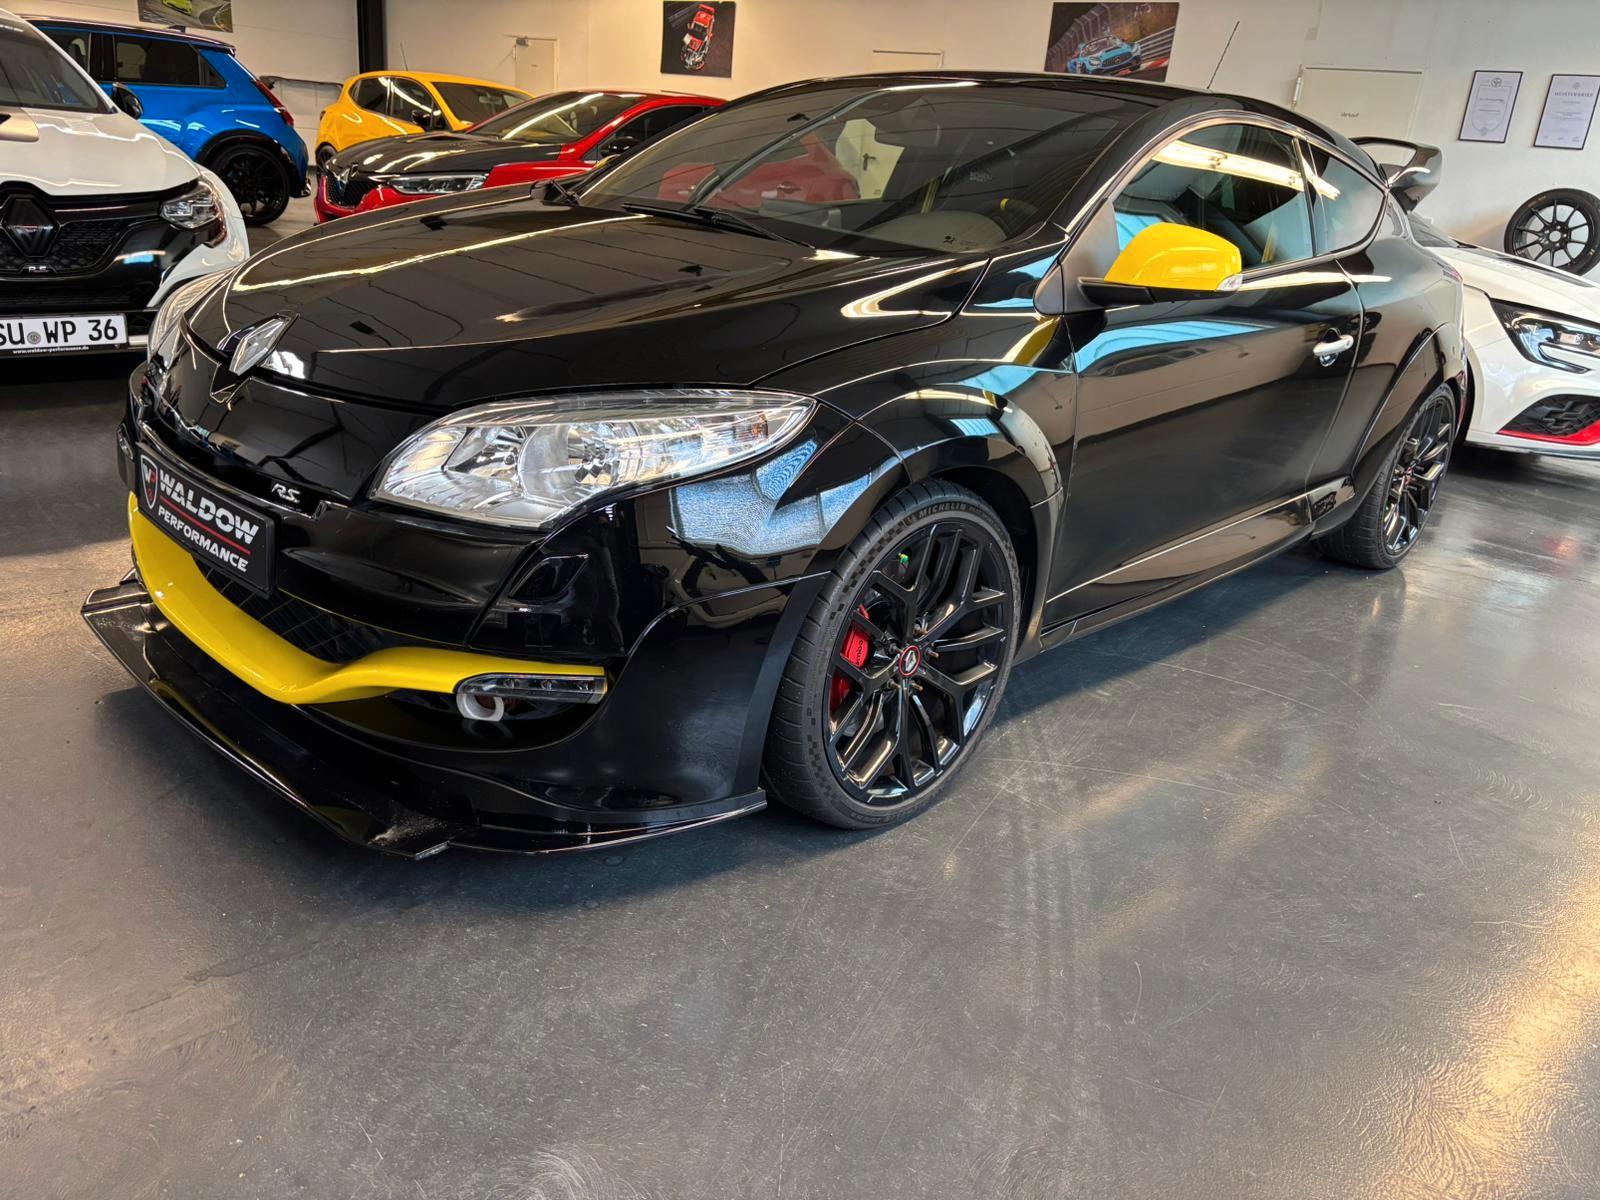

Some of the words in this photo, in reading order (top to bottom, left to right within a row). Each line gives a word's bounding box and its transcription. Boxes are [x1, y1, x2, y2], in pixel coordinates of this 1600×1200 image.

[43, 320, 76, 344] WP
[88, 319, 118, 341] 36
[160, 469, 259, 545] WALDOW
[919, 502, 967, 518] MICHELIN
[158, 505, 249, 572] PERFORMANCE
[855, 638, 864, 667] embo
